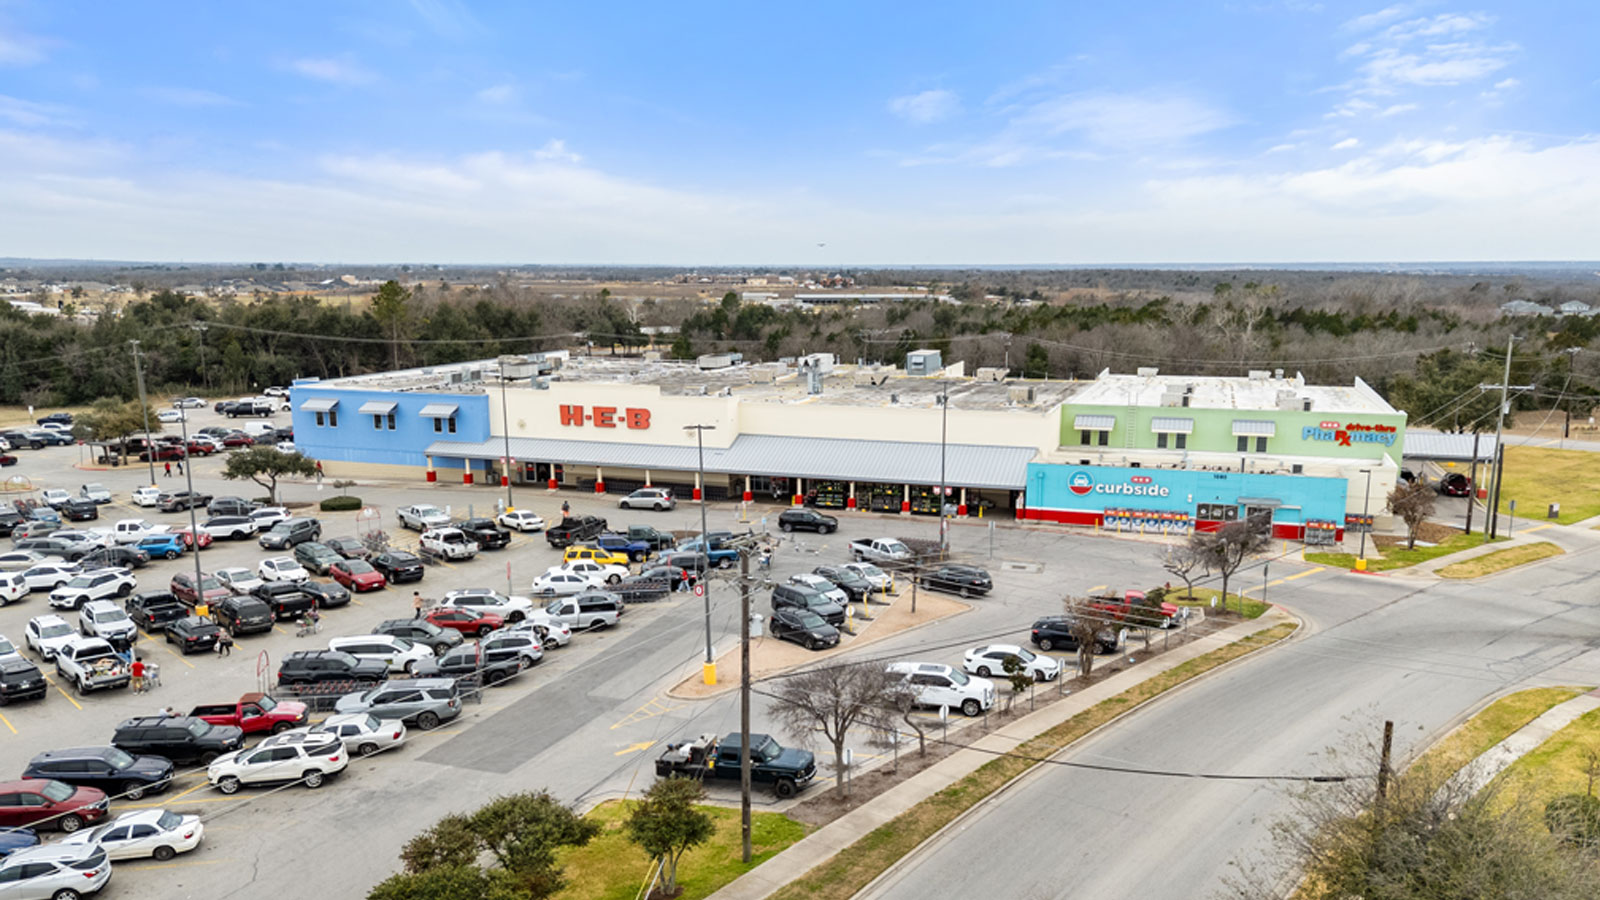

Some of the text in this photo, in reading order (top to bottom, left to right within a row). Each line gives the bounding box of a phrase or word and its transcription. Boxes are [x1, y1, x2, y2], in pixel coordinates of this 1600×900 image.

[559, 404, 651, 430] H-E-B
[1345, 422, 1397, 433] drive-thru
[1095, 482, 1170, 497] curbside
